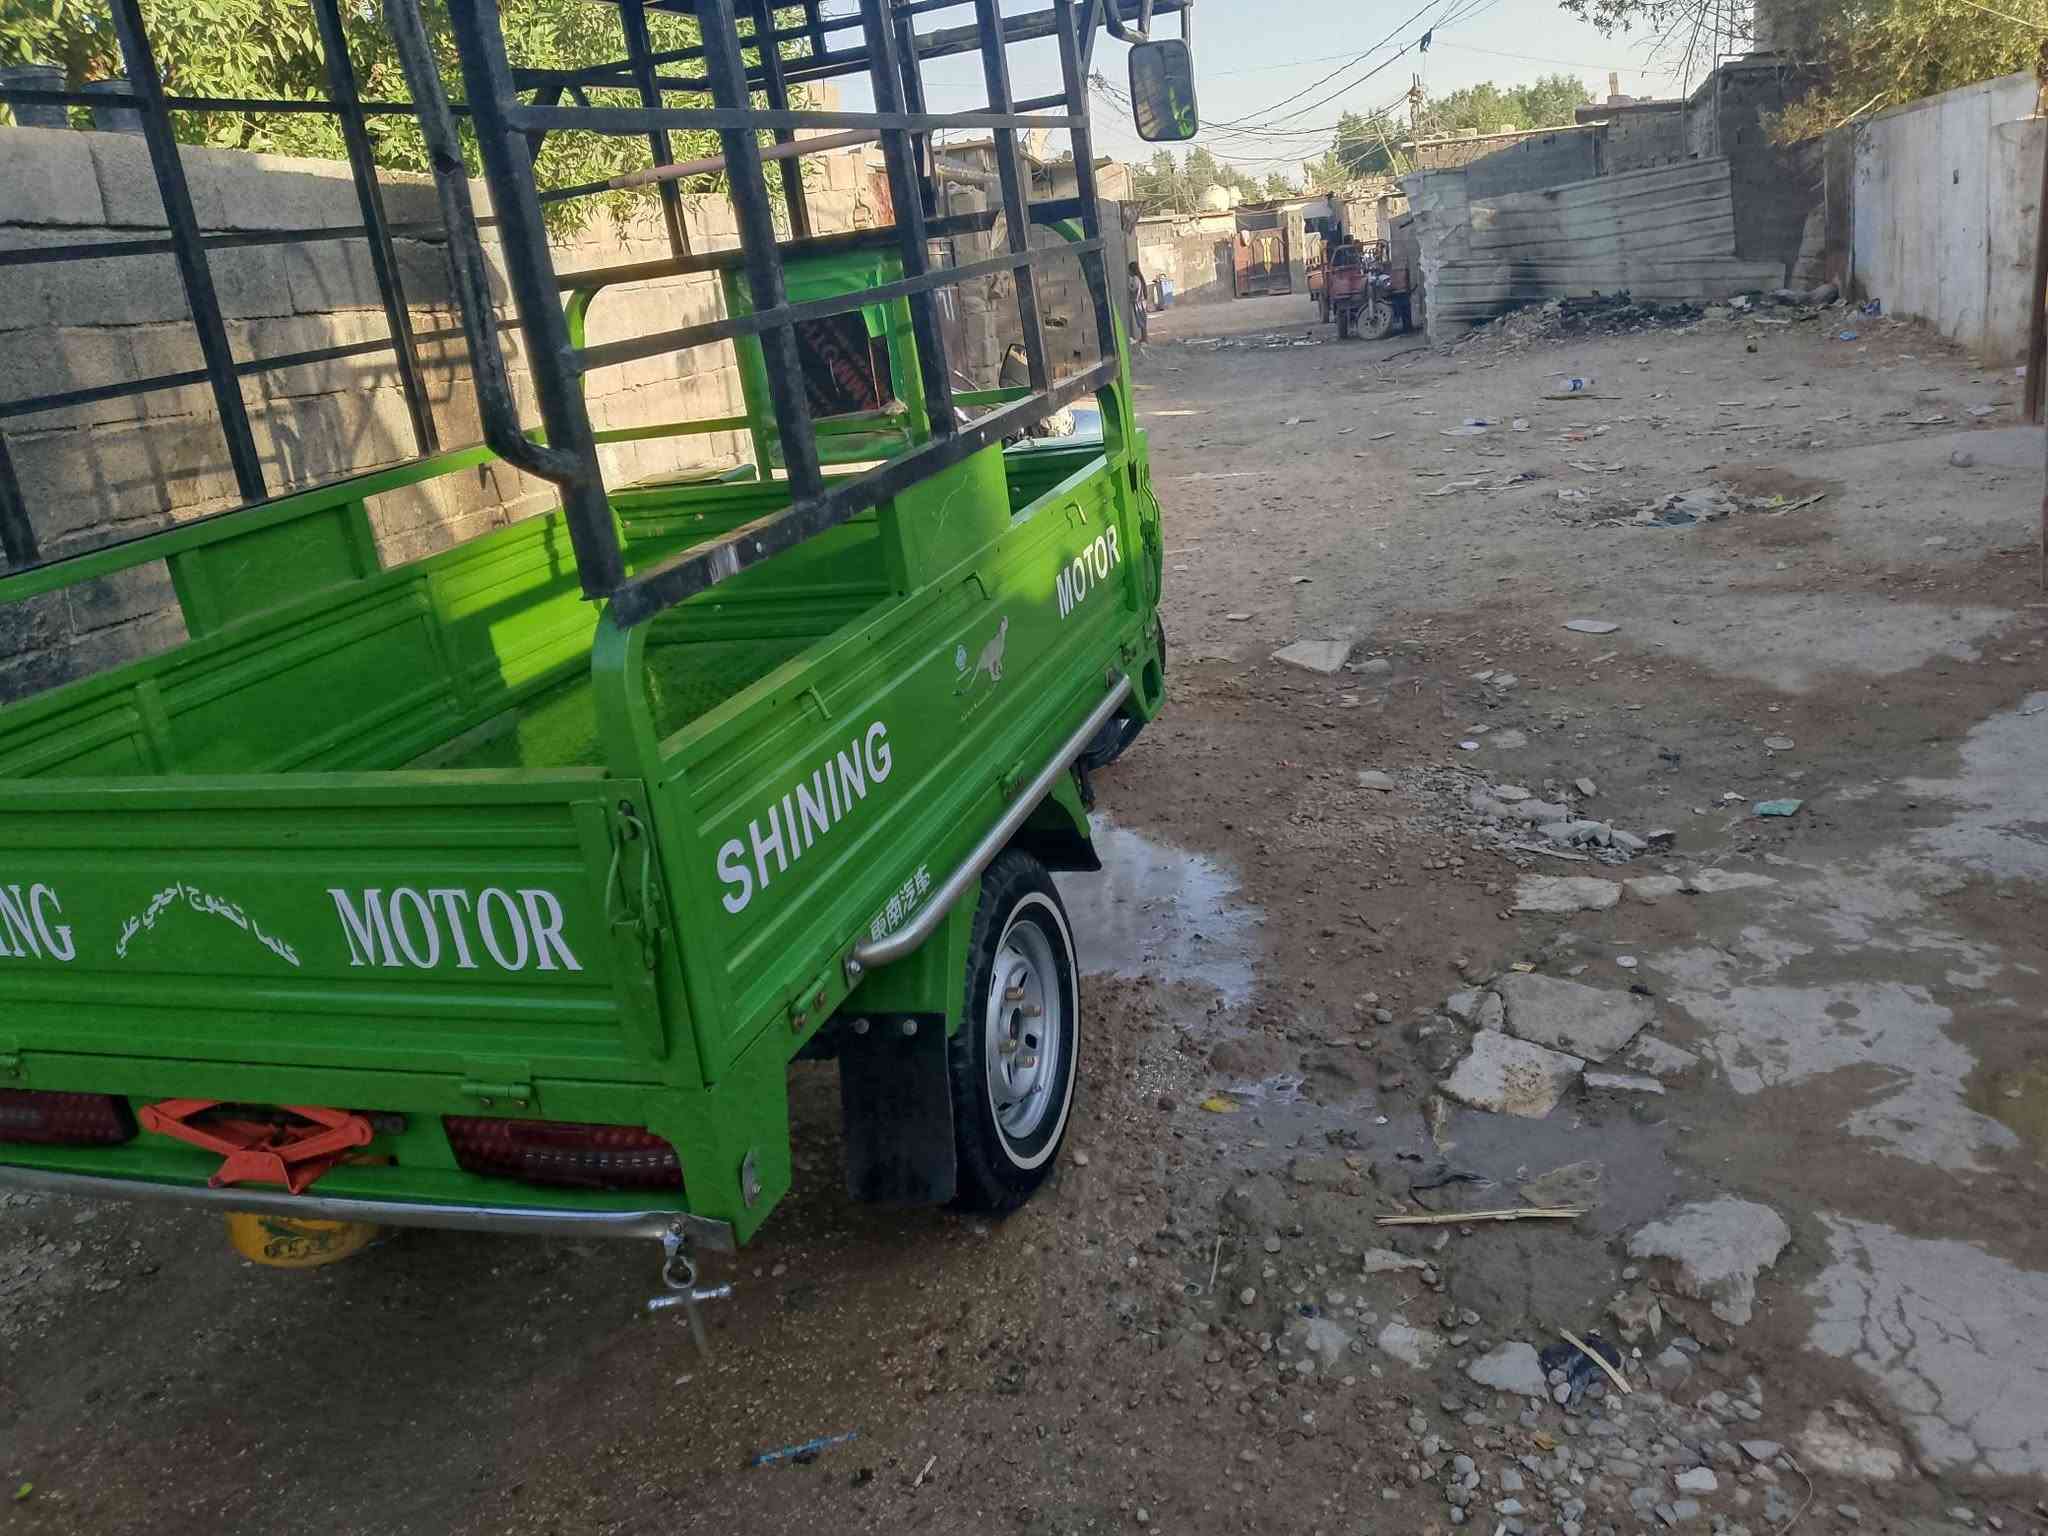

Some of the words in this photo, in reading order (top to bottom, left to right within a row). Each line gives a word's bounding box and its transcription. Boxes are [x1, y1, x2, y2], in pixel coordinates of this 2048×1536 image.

[717, 721, 892, 914] SHINING
[1056, 524, 1121, 620] MOTOR
[327, 887, 584, 971] MOTOR
